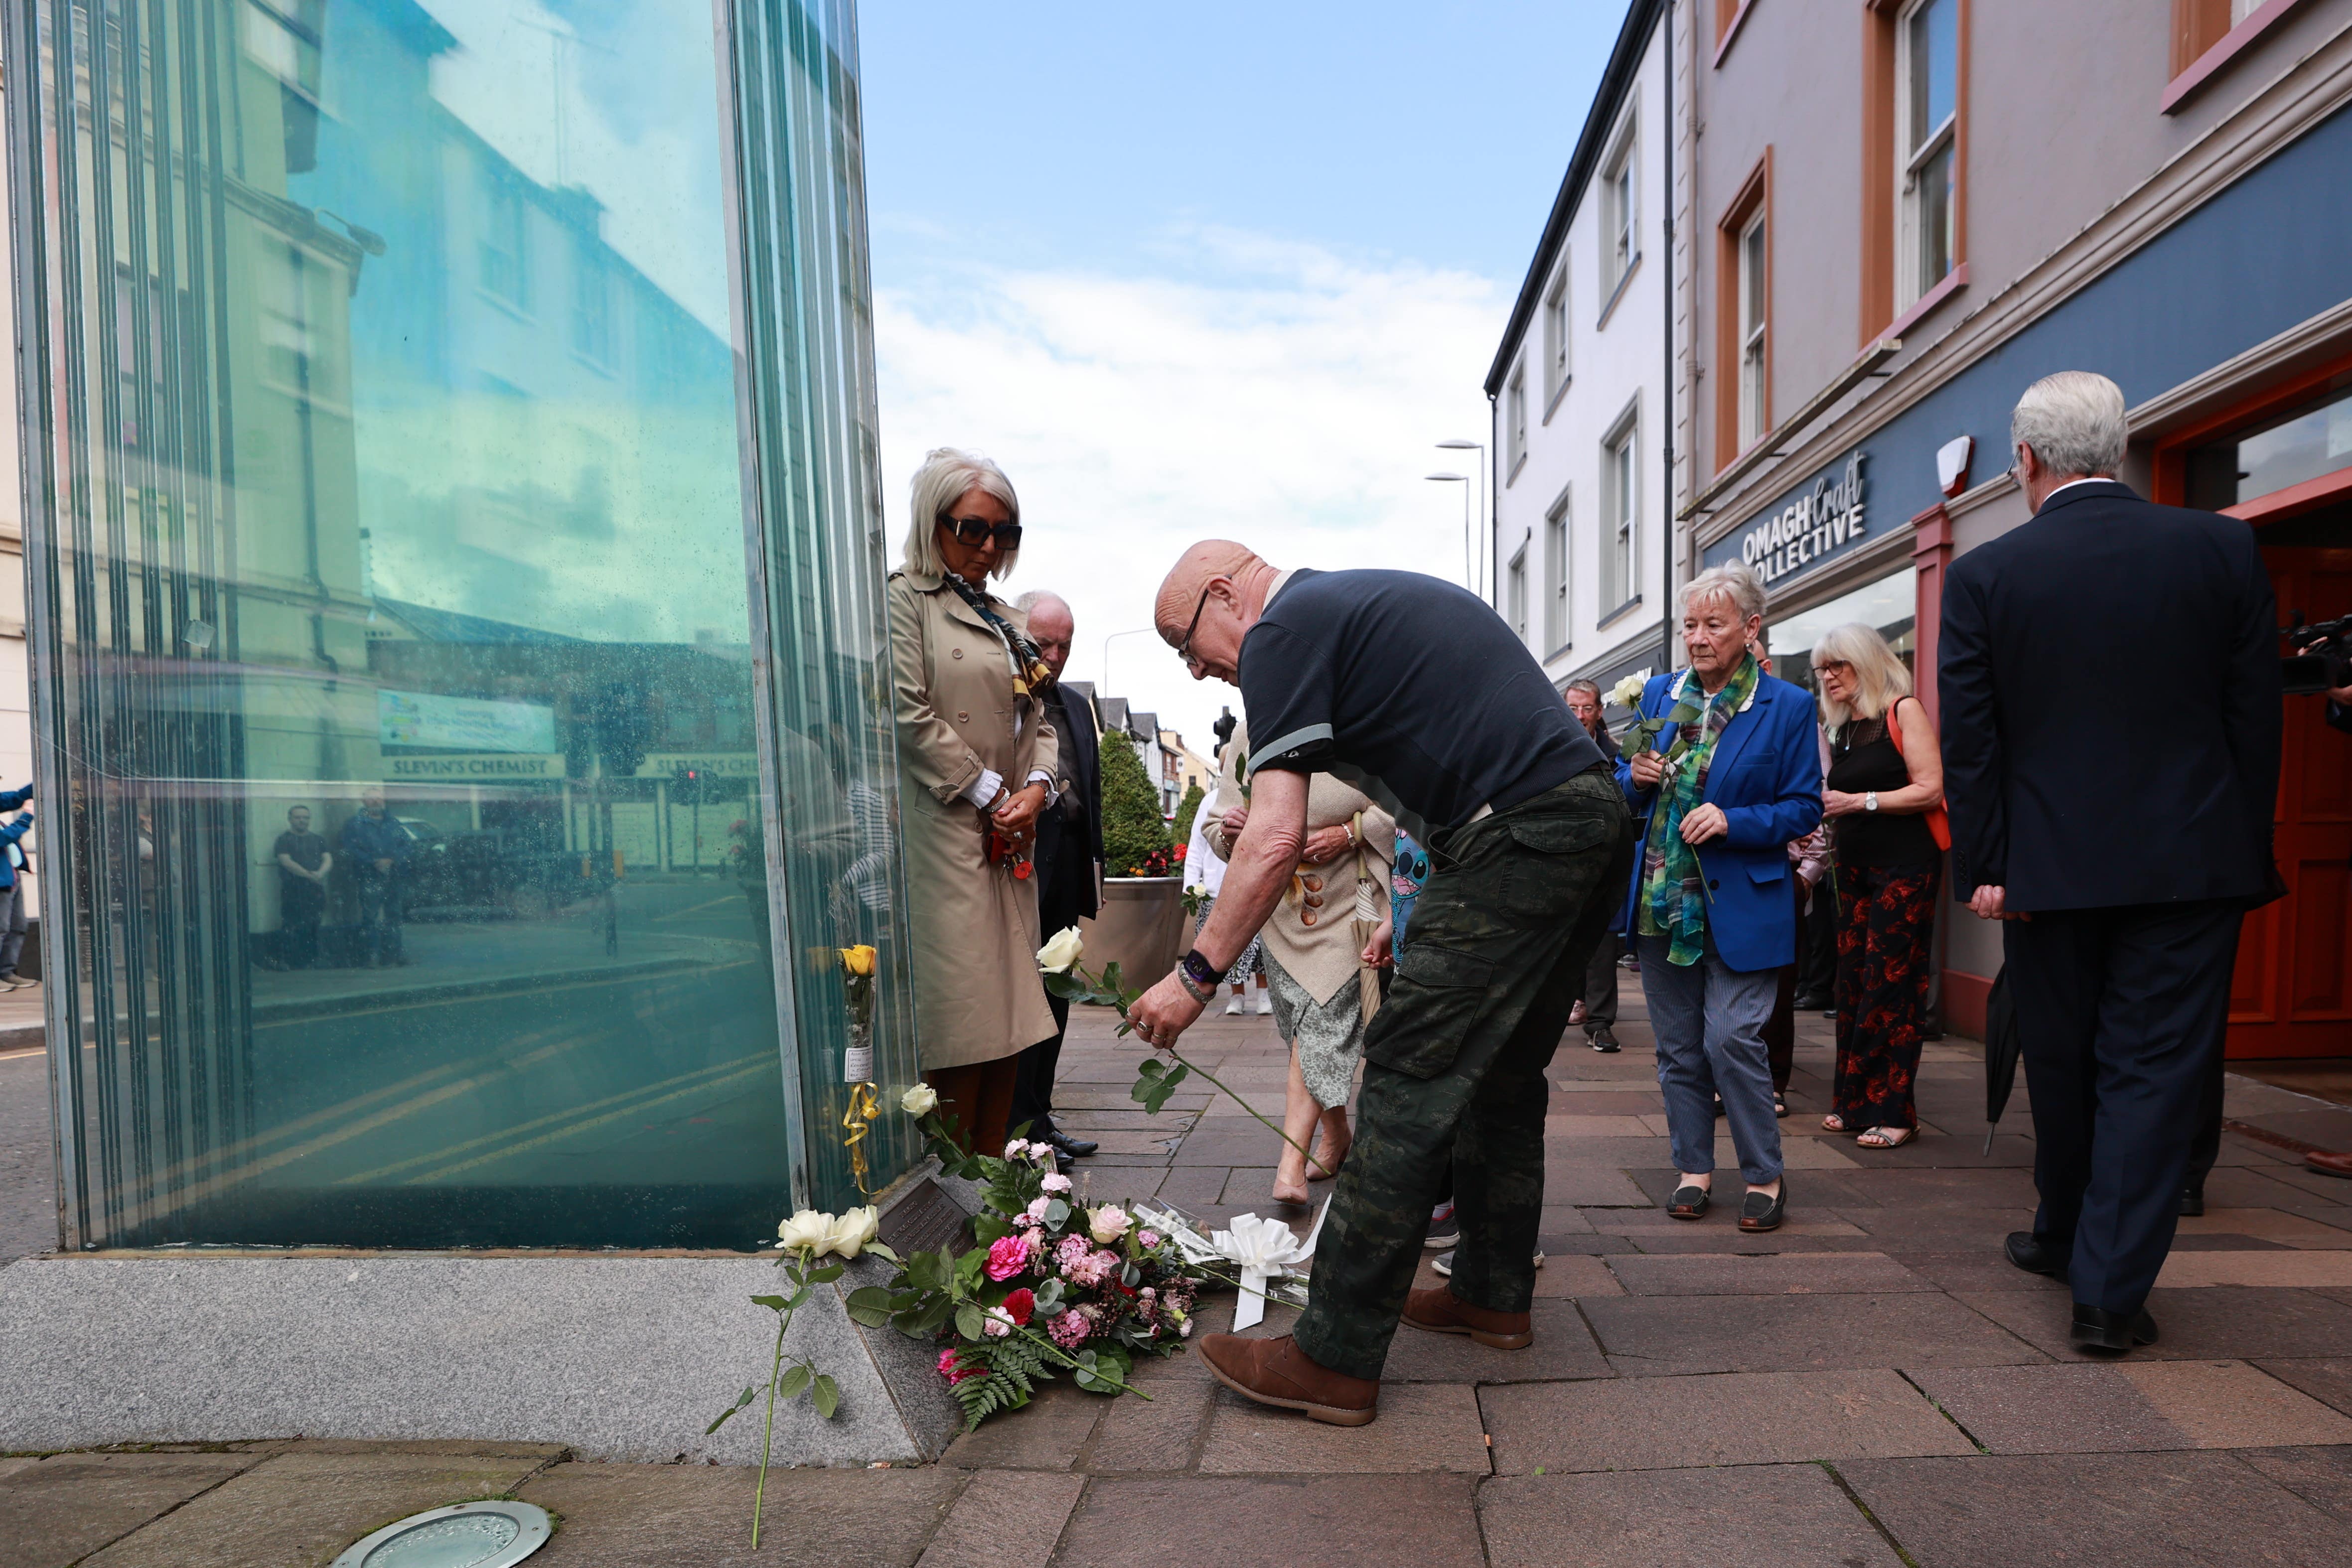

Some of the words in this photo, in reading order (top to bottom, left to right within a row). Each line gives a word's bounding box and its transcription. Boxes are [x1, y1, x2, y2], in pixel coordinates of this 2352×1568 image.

[1743, 495, 1811, 565] OMAGH
[1810, 450, 1867, 525] Craft
[1755, 503, 1866, 584] OLLECTIVE
[394, 759, 464, 773] SLEVIN'S
[468, 759, 548, 773] CHEMIST
